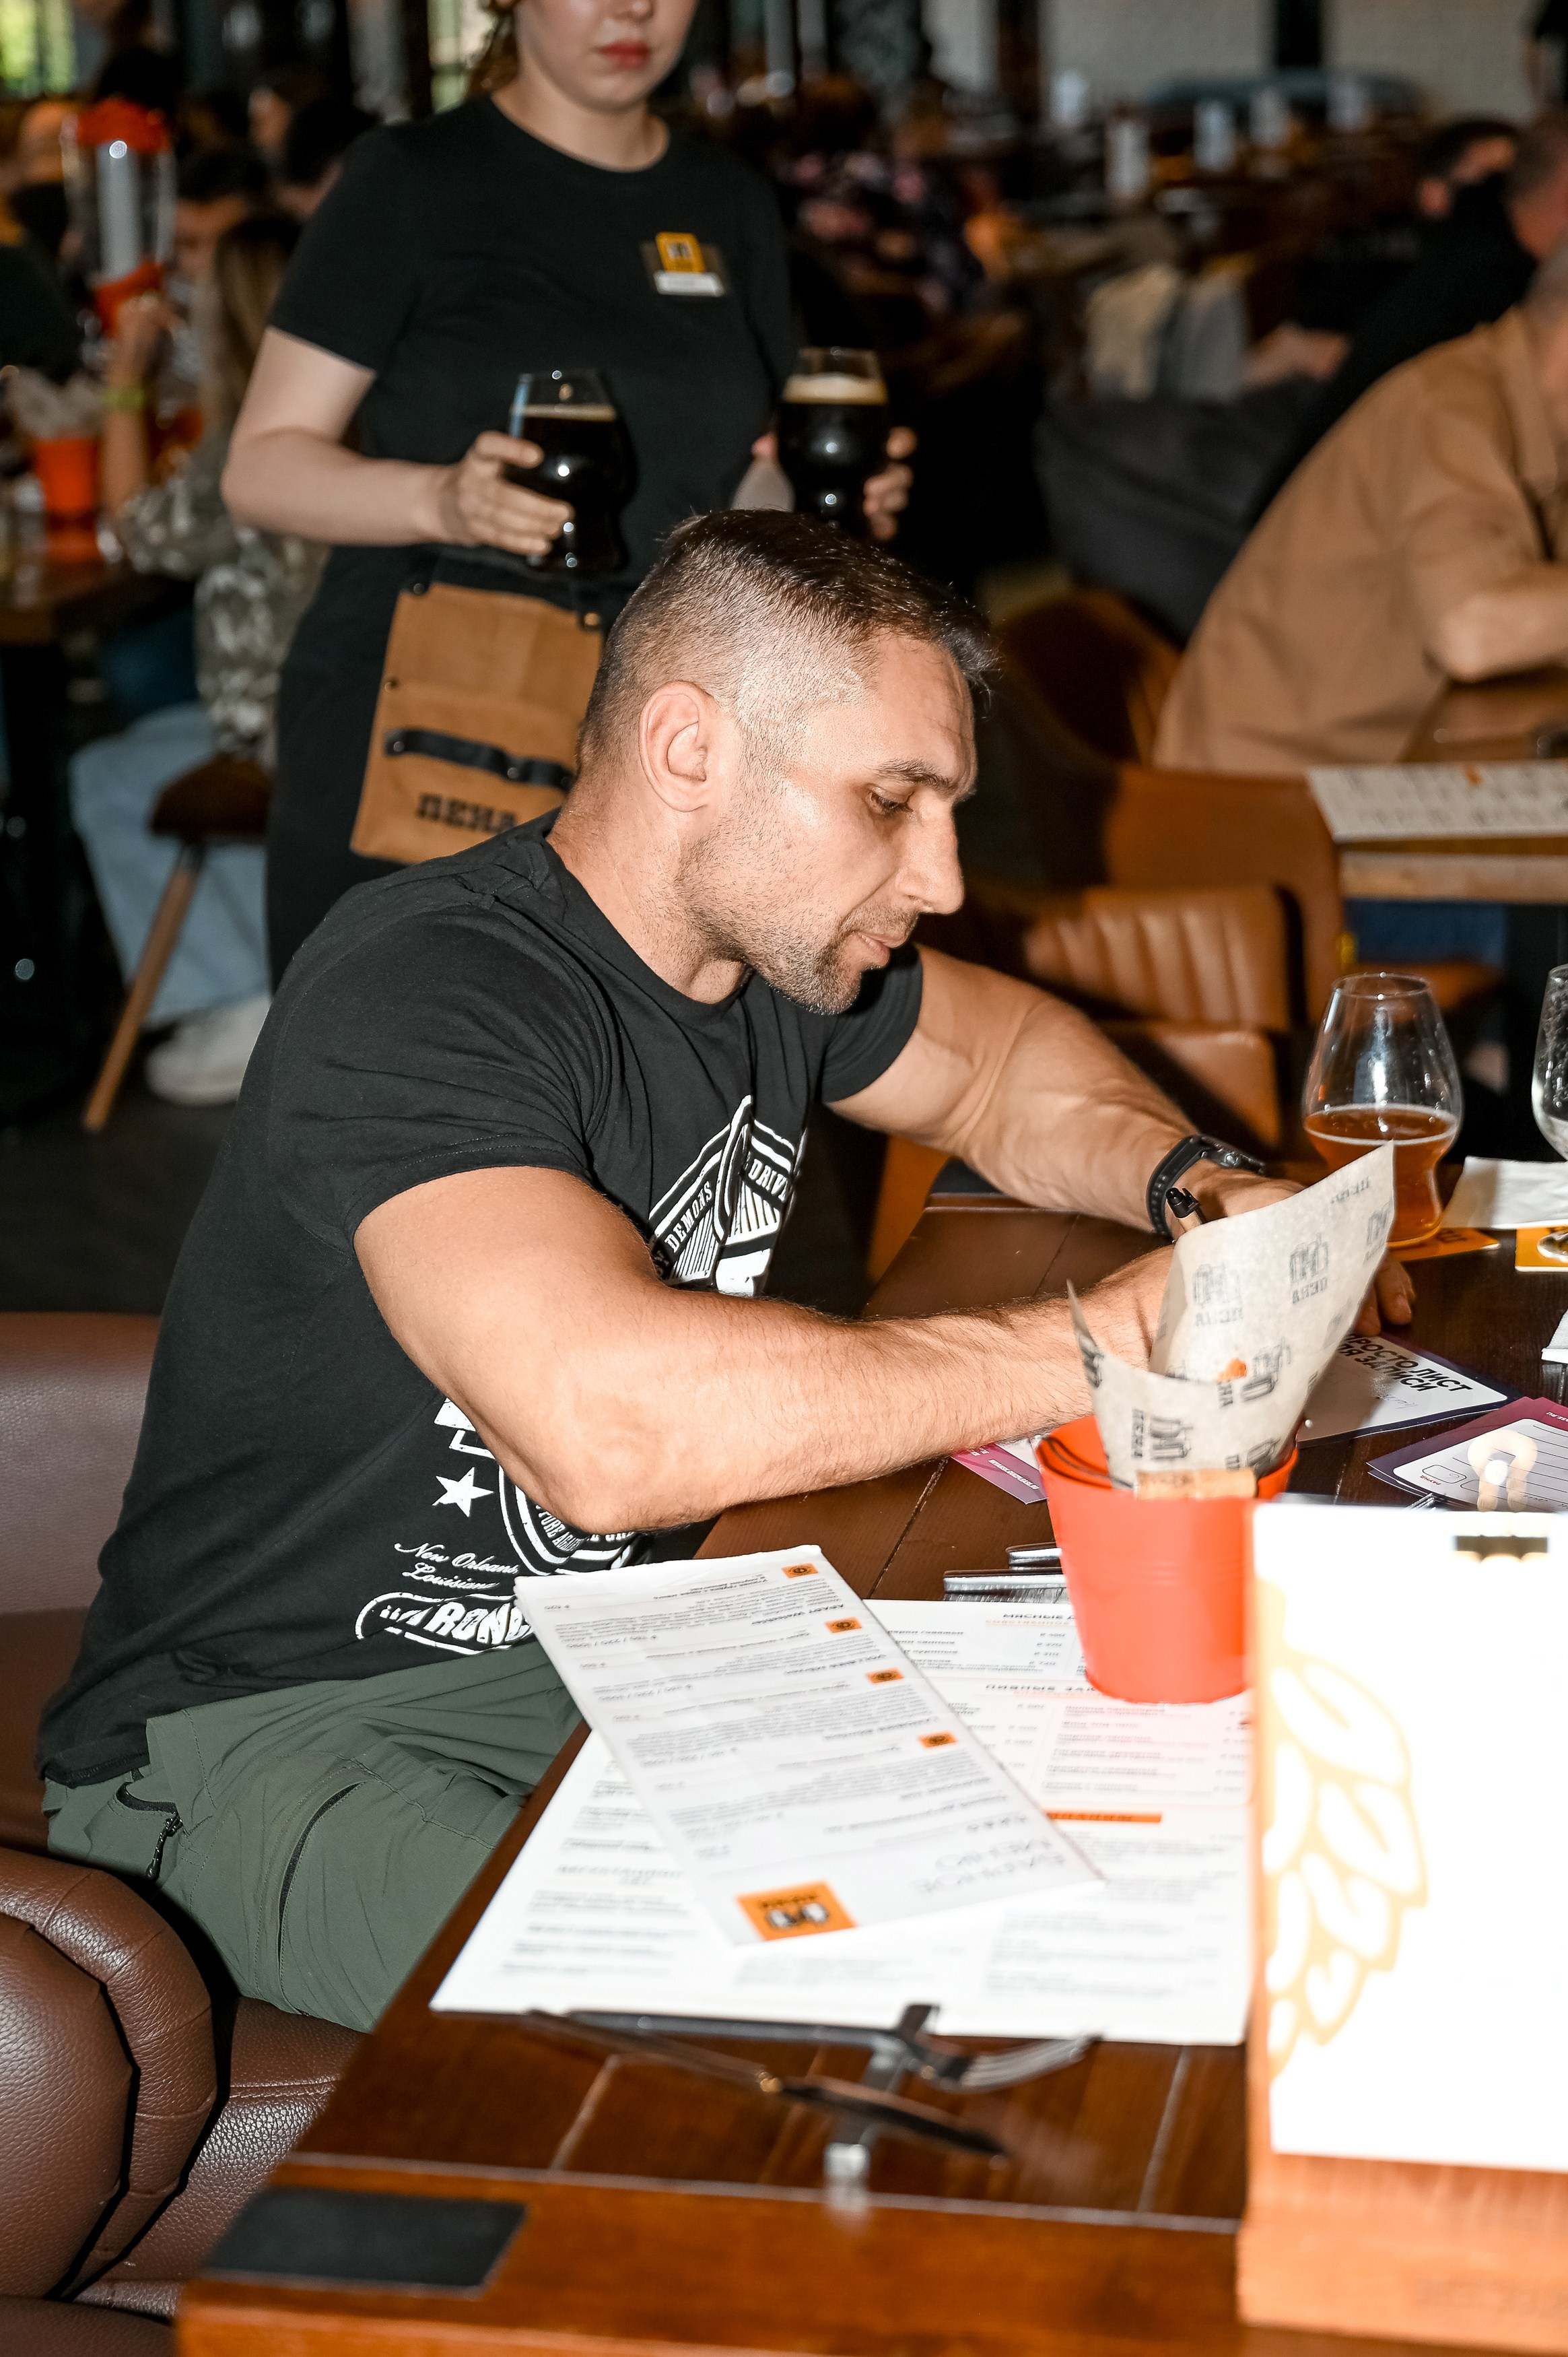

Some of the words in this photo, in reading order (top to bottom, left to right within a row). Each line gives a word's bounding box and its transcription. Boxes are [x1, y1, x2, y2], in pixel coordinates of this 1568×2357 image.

[665, 1181, 713, 1253] DEMONS
[1338, 1343, 1364, 1356] ЛЯ
[1355, 1356, 1439, 1392] ЗАПИСИ
[1409, 1368, 1473, 1392] ЛИСТ
[1420, 1475, 1442, 1486] РАУНД
[395, 1541, 448, 1562] New
[402, 1562, 500, 1590] Louisiana
